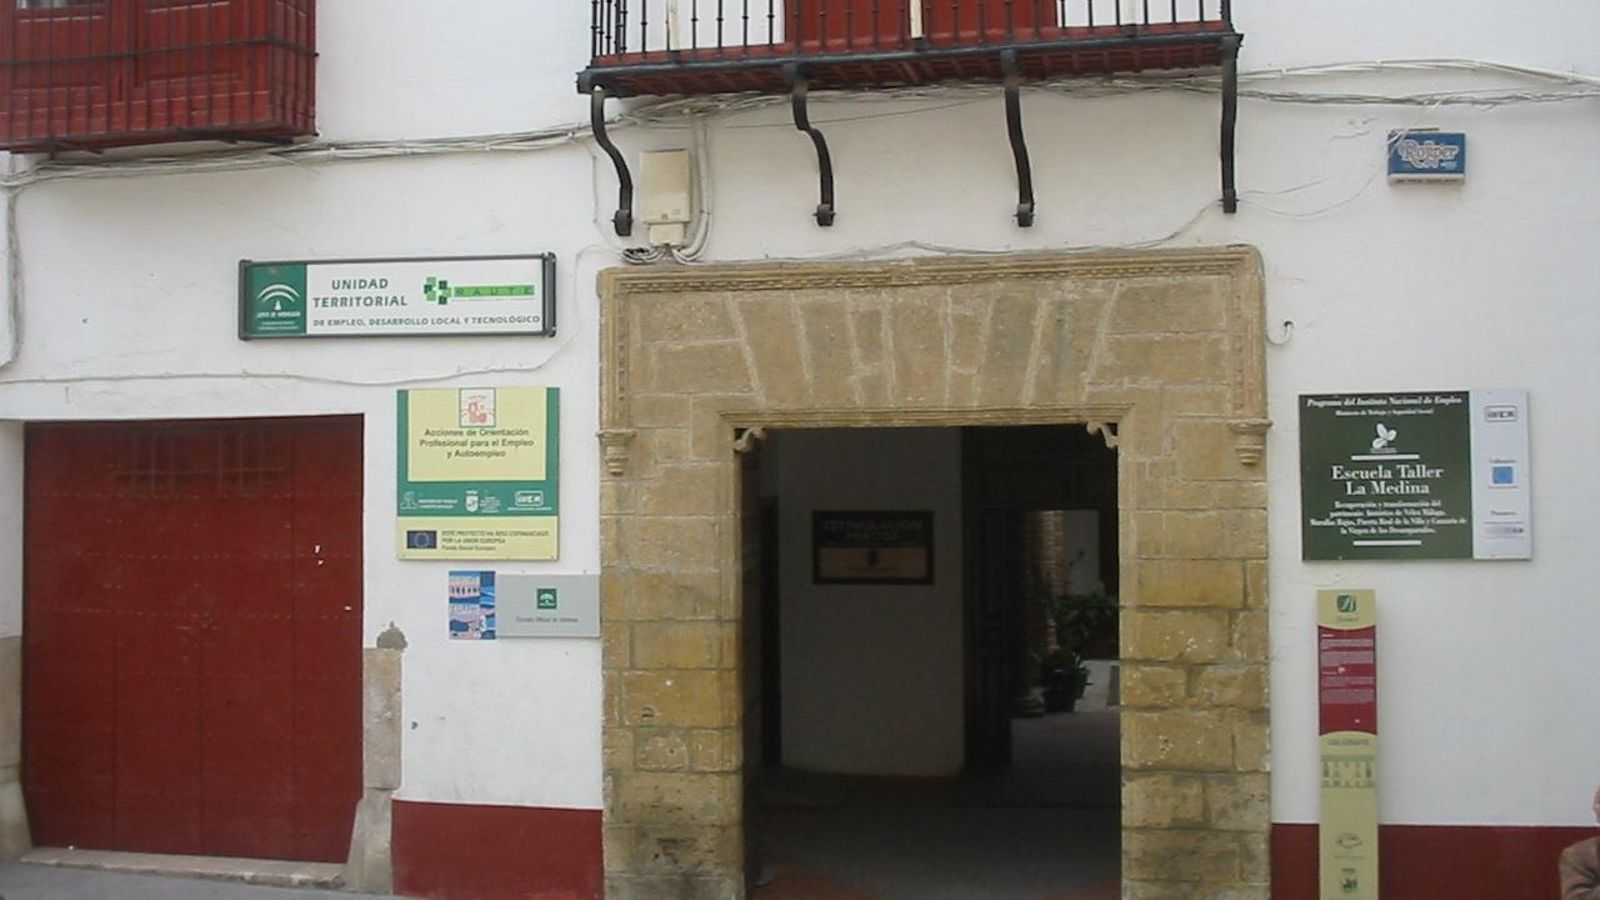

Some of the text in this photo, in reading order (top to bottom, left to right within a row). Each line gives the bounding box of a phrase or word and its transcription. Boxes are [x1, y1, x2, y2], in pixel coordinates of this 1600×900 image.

[331, 278, 388, 290] UNIDAD
[312, 295, 407, 308] TERRITORIAL
[327, 319, 366, 328] EMPLEO,
[368, 318, 428, 326] DESARROLLO
[430, 317, 460, 325] LOCAL
[471, 315, 541, 324] TECNOLÓGICO
[1343, 398, 1356, 406] del
[1423, 396, 1433, 404] de
[424, 429, 463, 437] Acciones
[480, 428, 529, 437] Orientación
[419, 438, 535, 449] Profesional para el Empleo
[446, 450, 506, 460] y Autoempleo
[1331, 464, 1444, 480] Escuela Taller
[1346, 480, 1430, 496] La Medina
